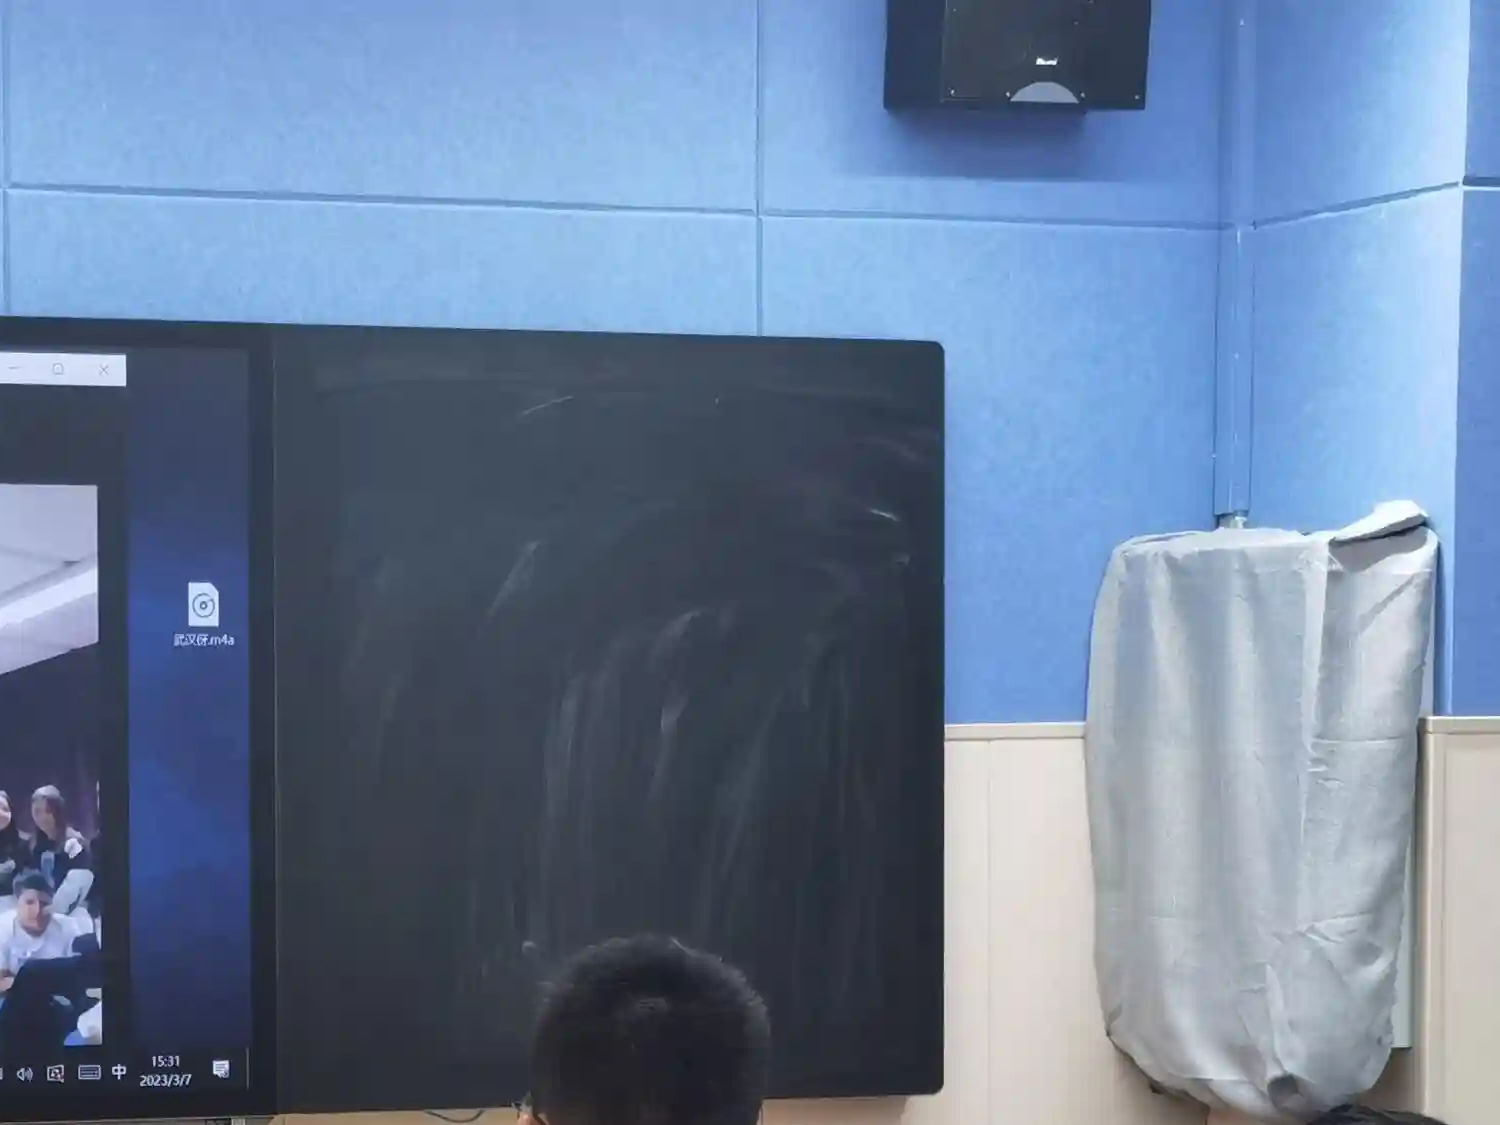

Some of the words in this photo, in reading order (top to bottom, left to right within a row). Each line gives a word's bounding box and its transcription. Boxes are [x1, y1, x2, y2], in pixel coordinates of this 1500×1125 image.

[152, 1055, 180, 1068] 15:31
[111, 1063, 127, 1080] 中
[140, 1073, 192, 1087] 2023/3/7
